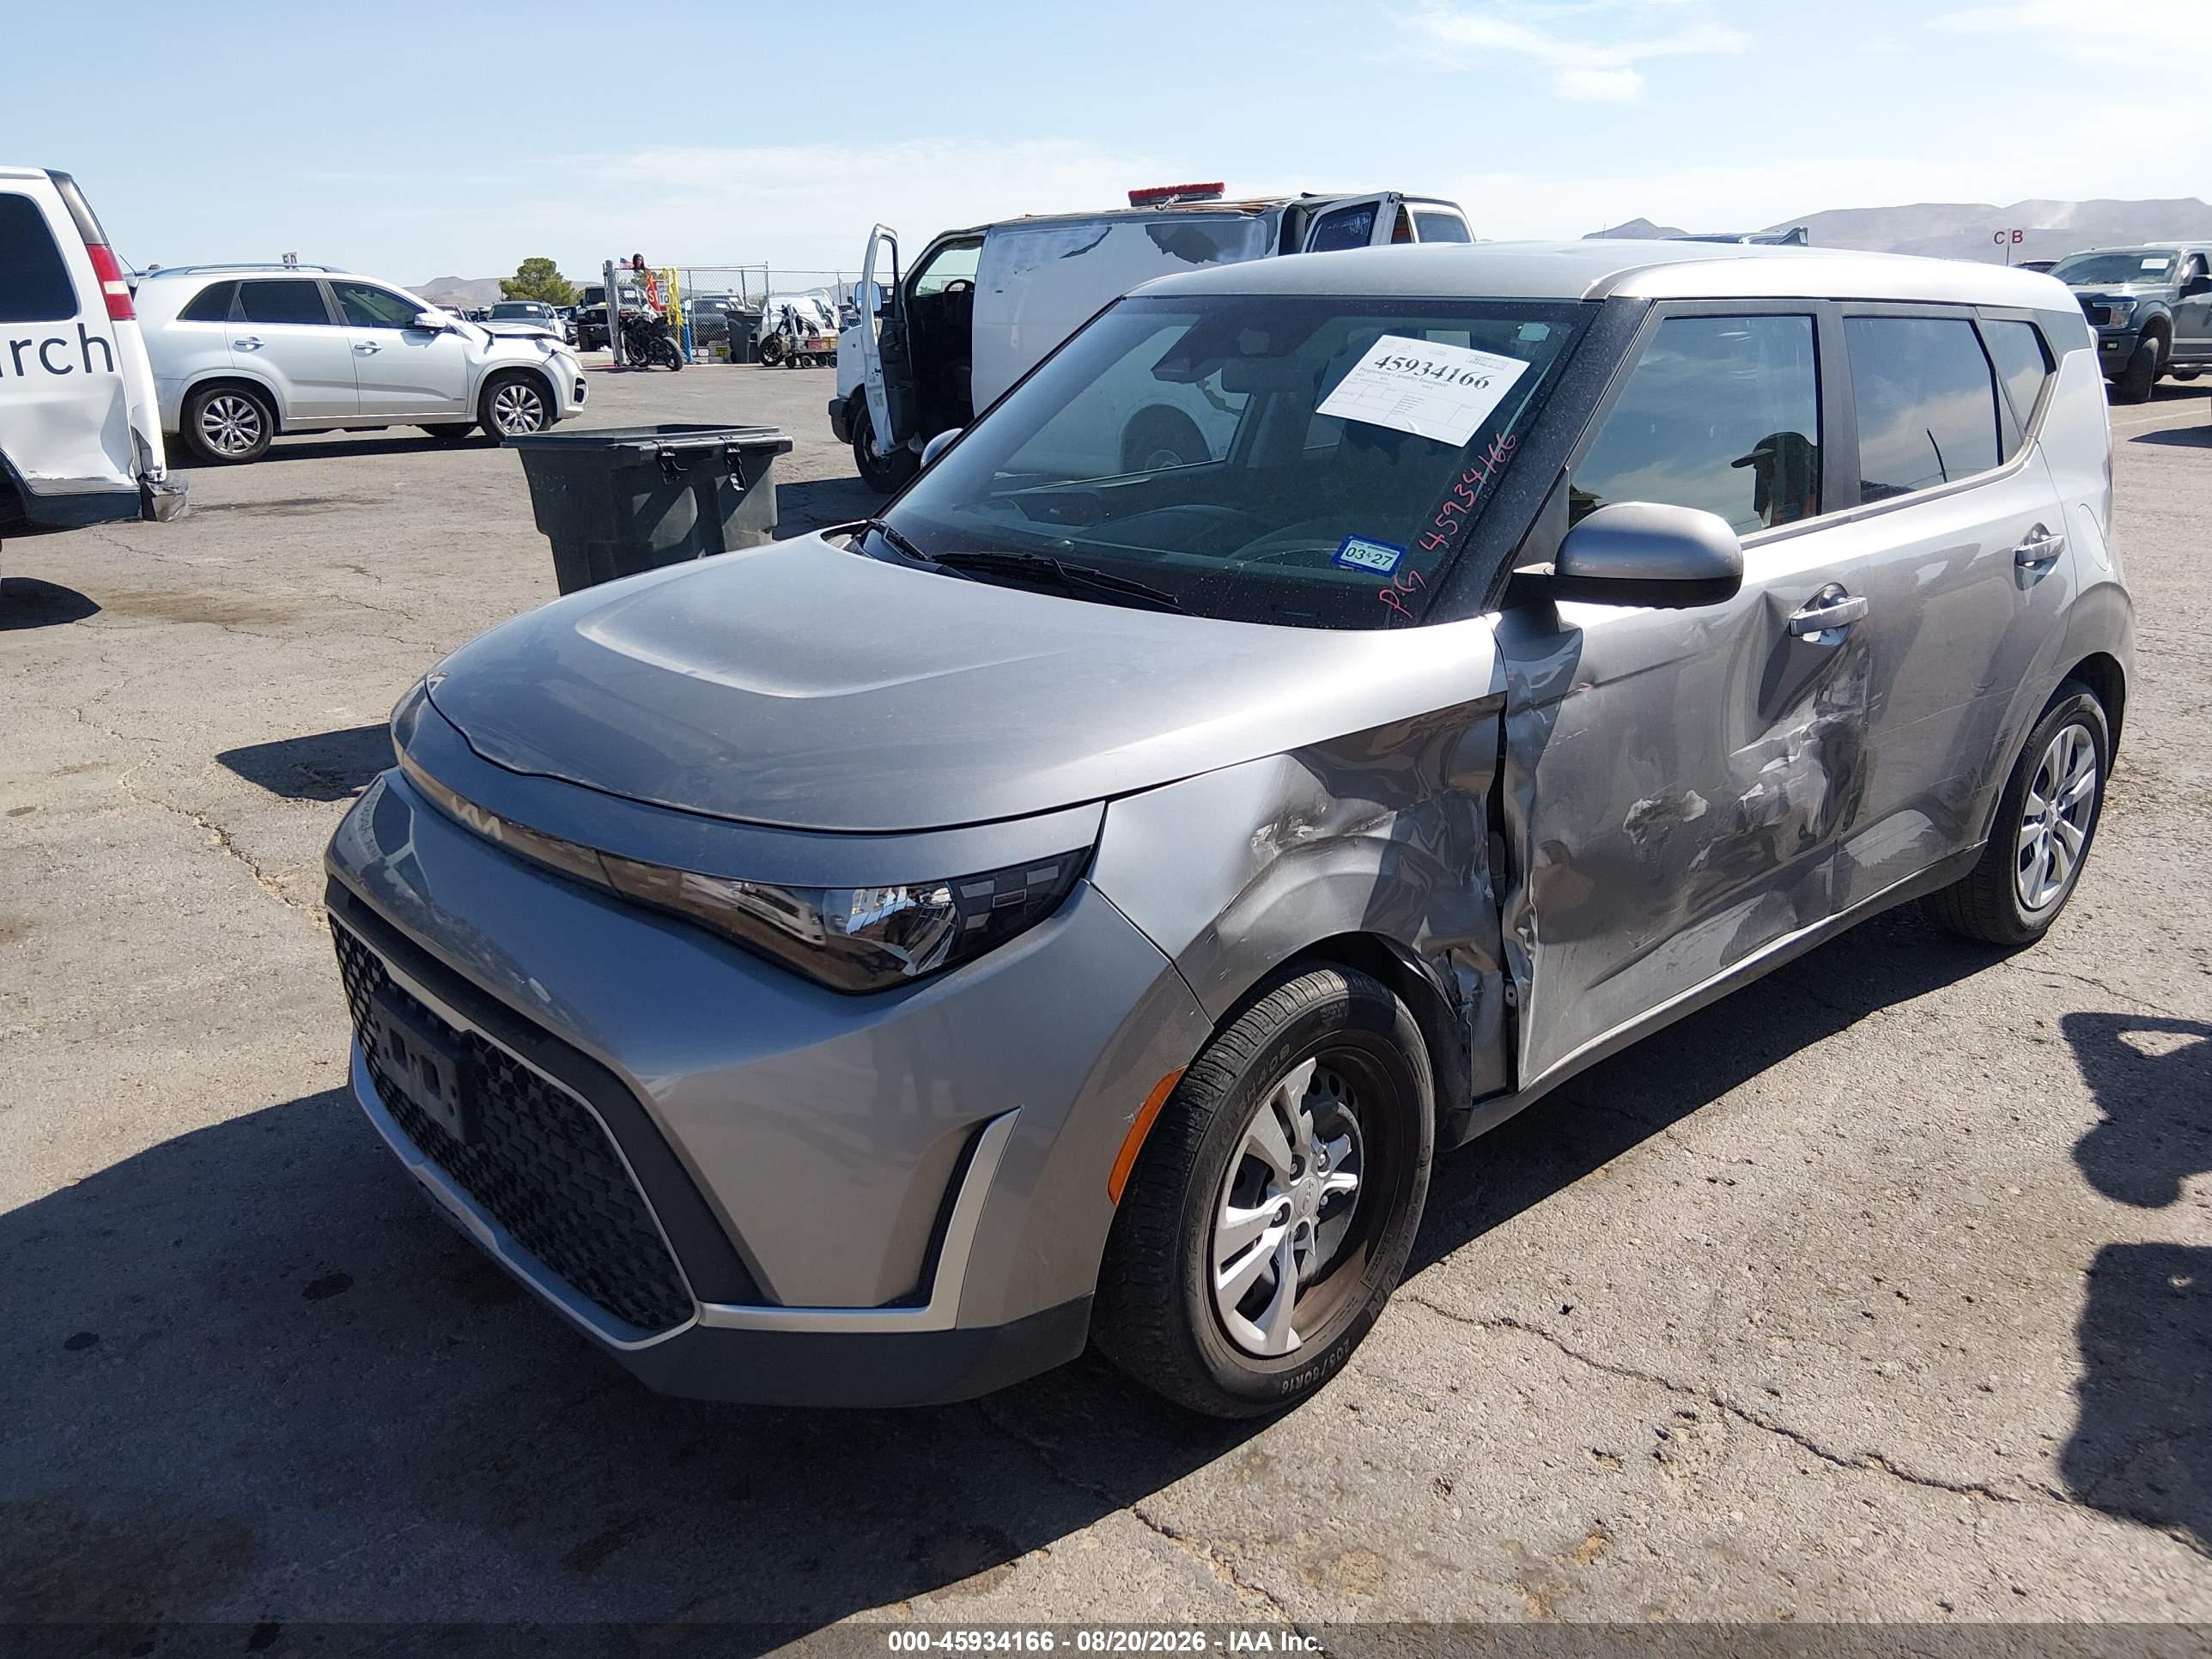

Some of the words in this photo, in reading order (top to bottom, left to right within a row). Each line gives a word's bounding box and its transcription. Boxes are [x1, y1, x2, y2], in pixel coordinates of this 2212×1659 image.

[1994, 231, 2006, 245] C
[2012, 229, 2023, 244] B
[660, 295, 670, 304] 10
[0, 323, 114, 377] rch
[1374, 355, 1495, 390] 45934166
[1419, 433, 1516, 550] 45934166
[1346, 547, 1365, 560] 03
[1371, 553, 1393, 566] 27
[453, 794, 502, 840] KIA
